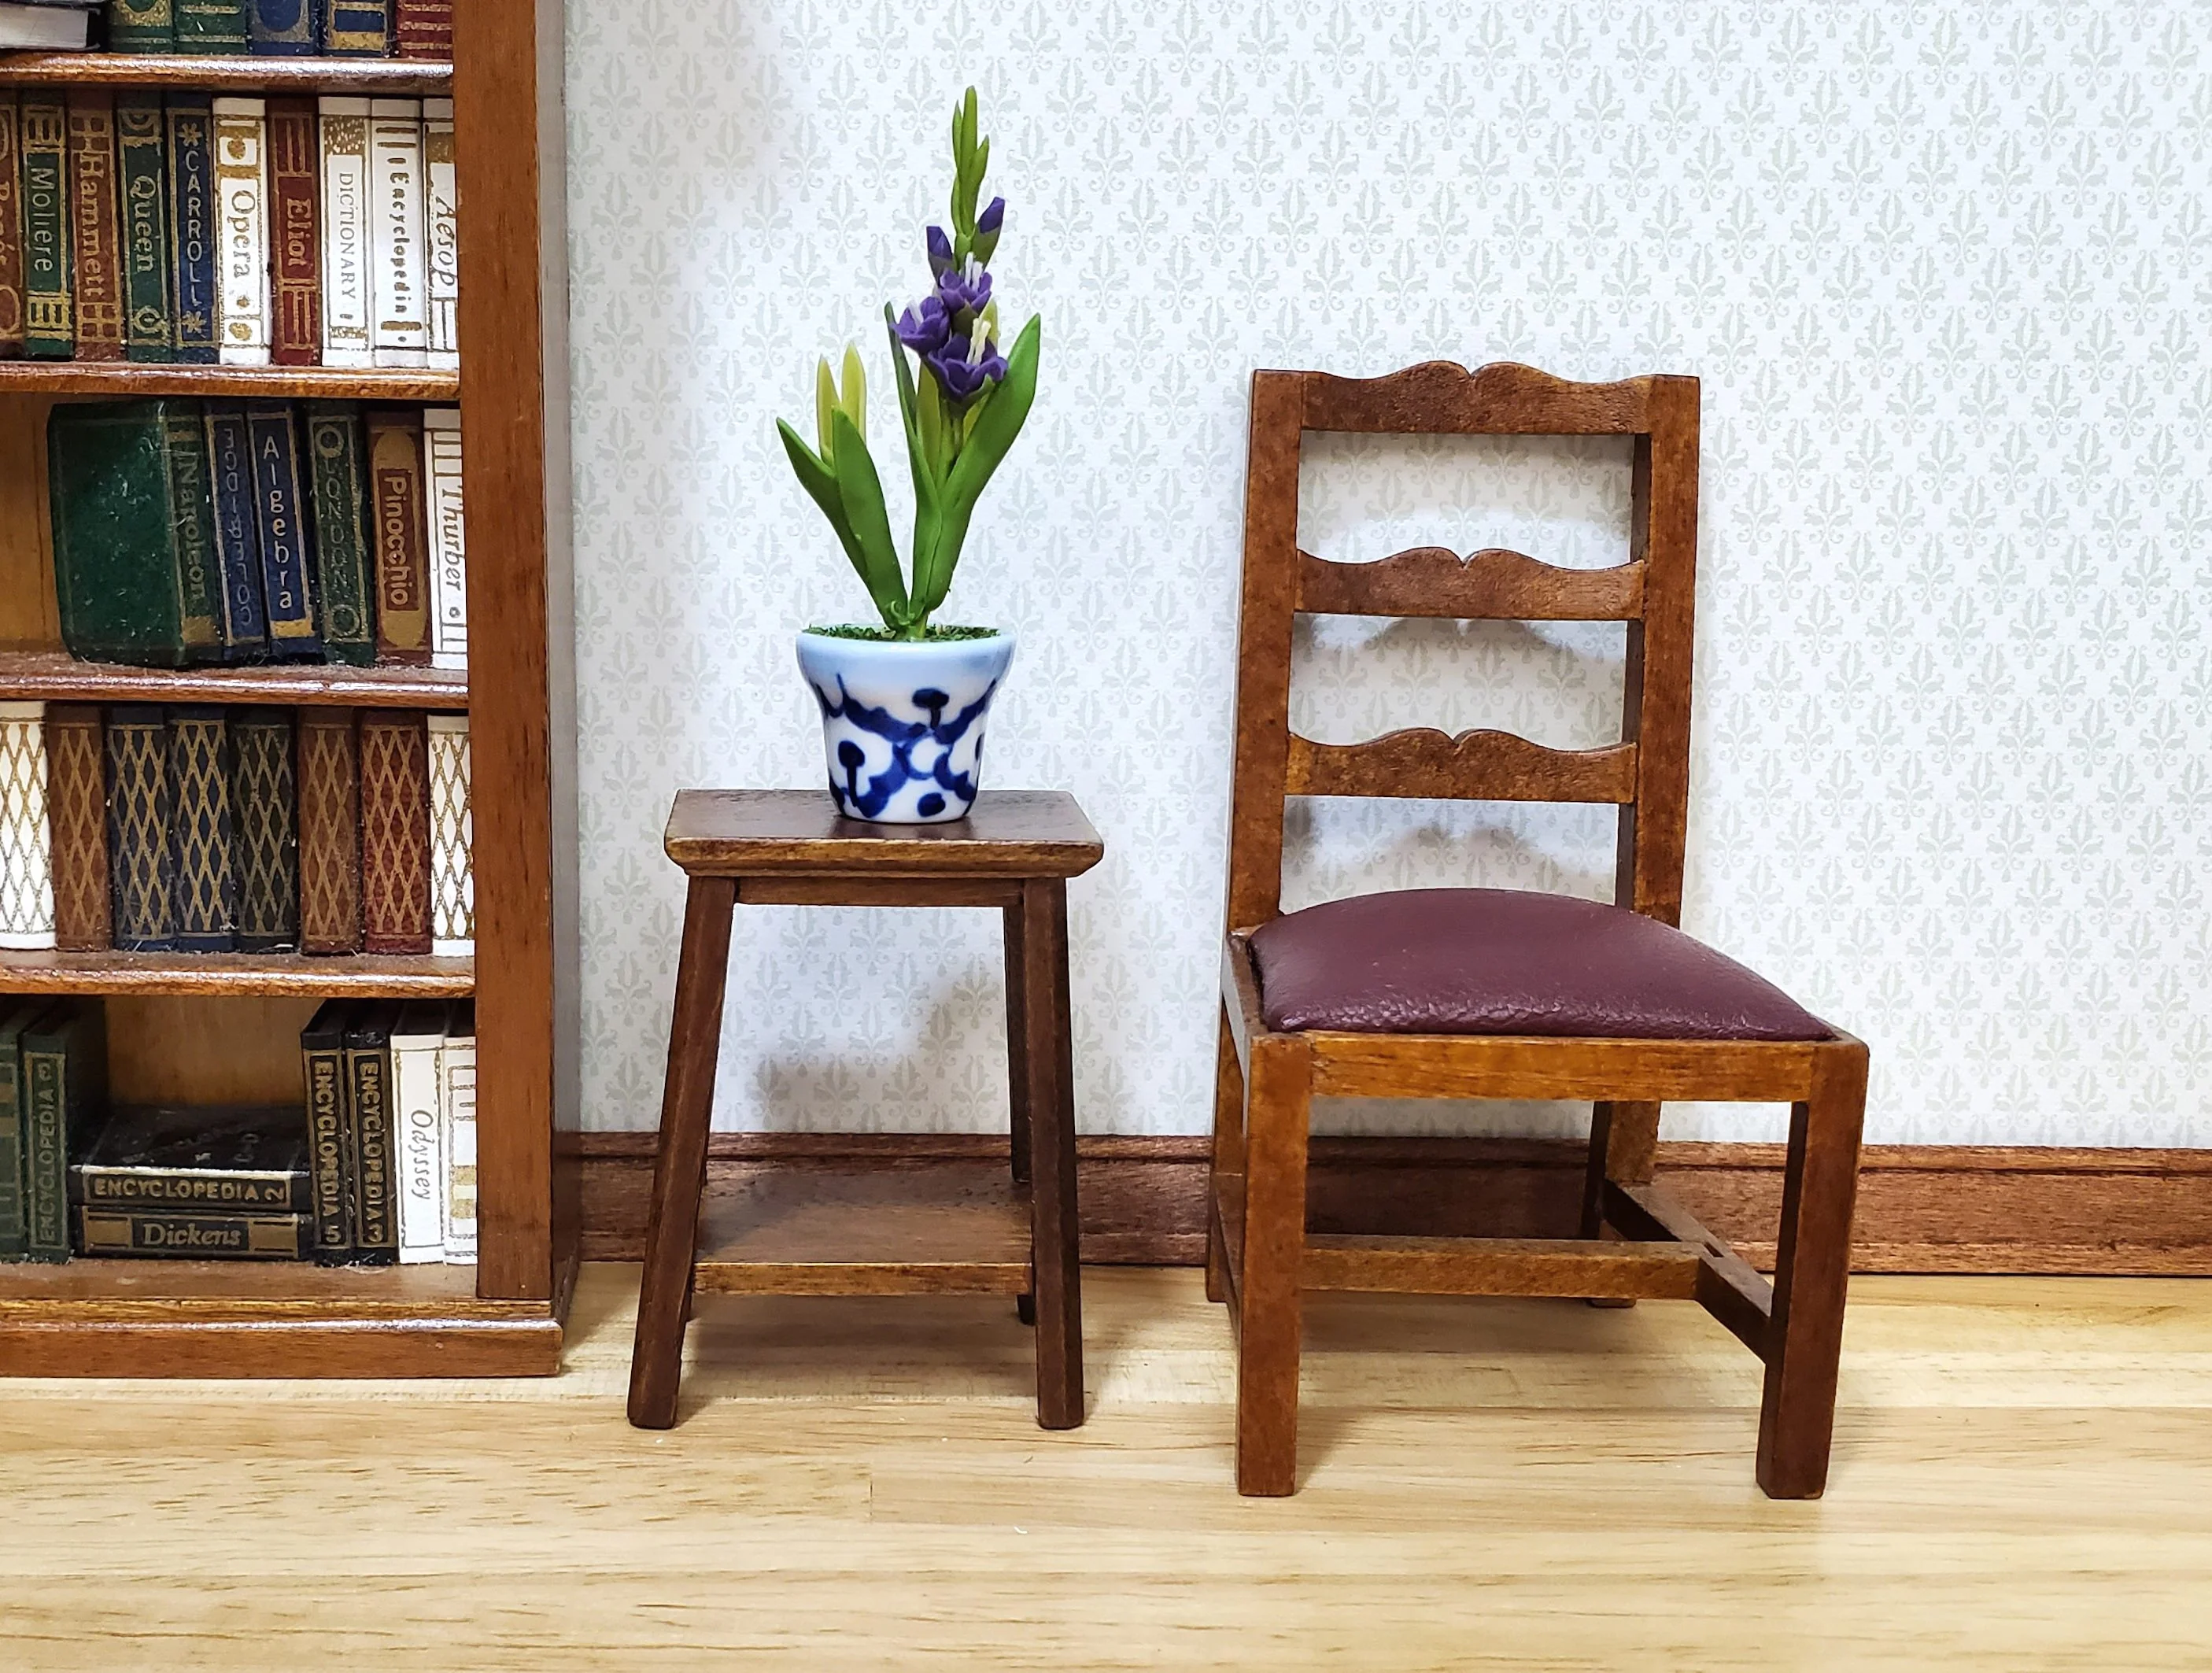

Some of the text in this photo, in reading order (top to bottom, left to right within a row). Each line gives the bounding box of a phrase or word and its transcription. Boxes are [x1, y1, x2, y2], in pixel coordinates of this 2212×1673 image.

[79, 153, 104, 297] Hammett
[129, 175, 157, 272] Queen
[186, 150, 203, 306] CARROLL
[227, 190, 256, 278] Opera
[286, 198, 312, 266] Eliot
[339, 172, 356, 299] DICTIONARY
[431, 196, 456, 286] Aesop
[177, 453, 205, 600] Napoleon
[264, 435, 294, 609] Algebra
[384, 476, 413, 605] Pinocchio
[442, 485, 463, 592] Thurber
[39, 1088, 55, 1241] ENCYCLOPEDIA
[94, 1178, 259, 1201] ENCYCLOPEDIA
[314, 1062, 340, 1217] ENCYCLOPEDIA
[359, 1062, 383, 1221] ENCYCLOPEDIA
[408, 1110, 434, 1200] Odyssey
[142, 1223, 241, 1246] Dickens
